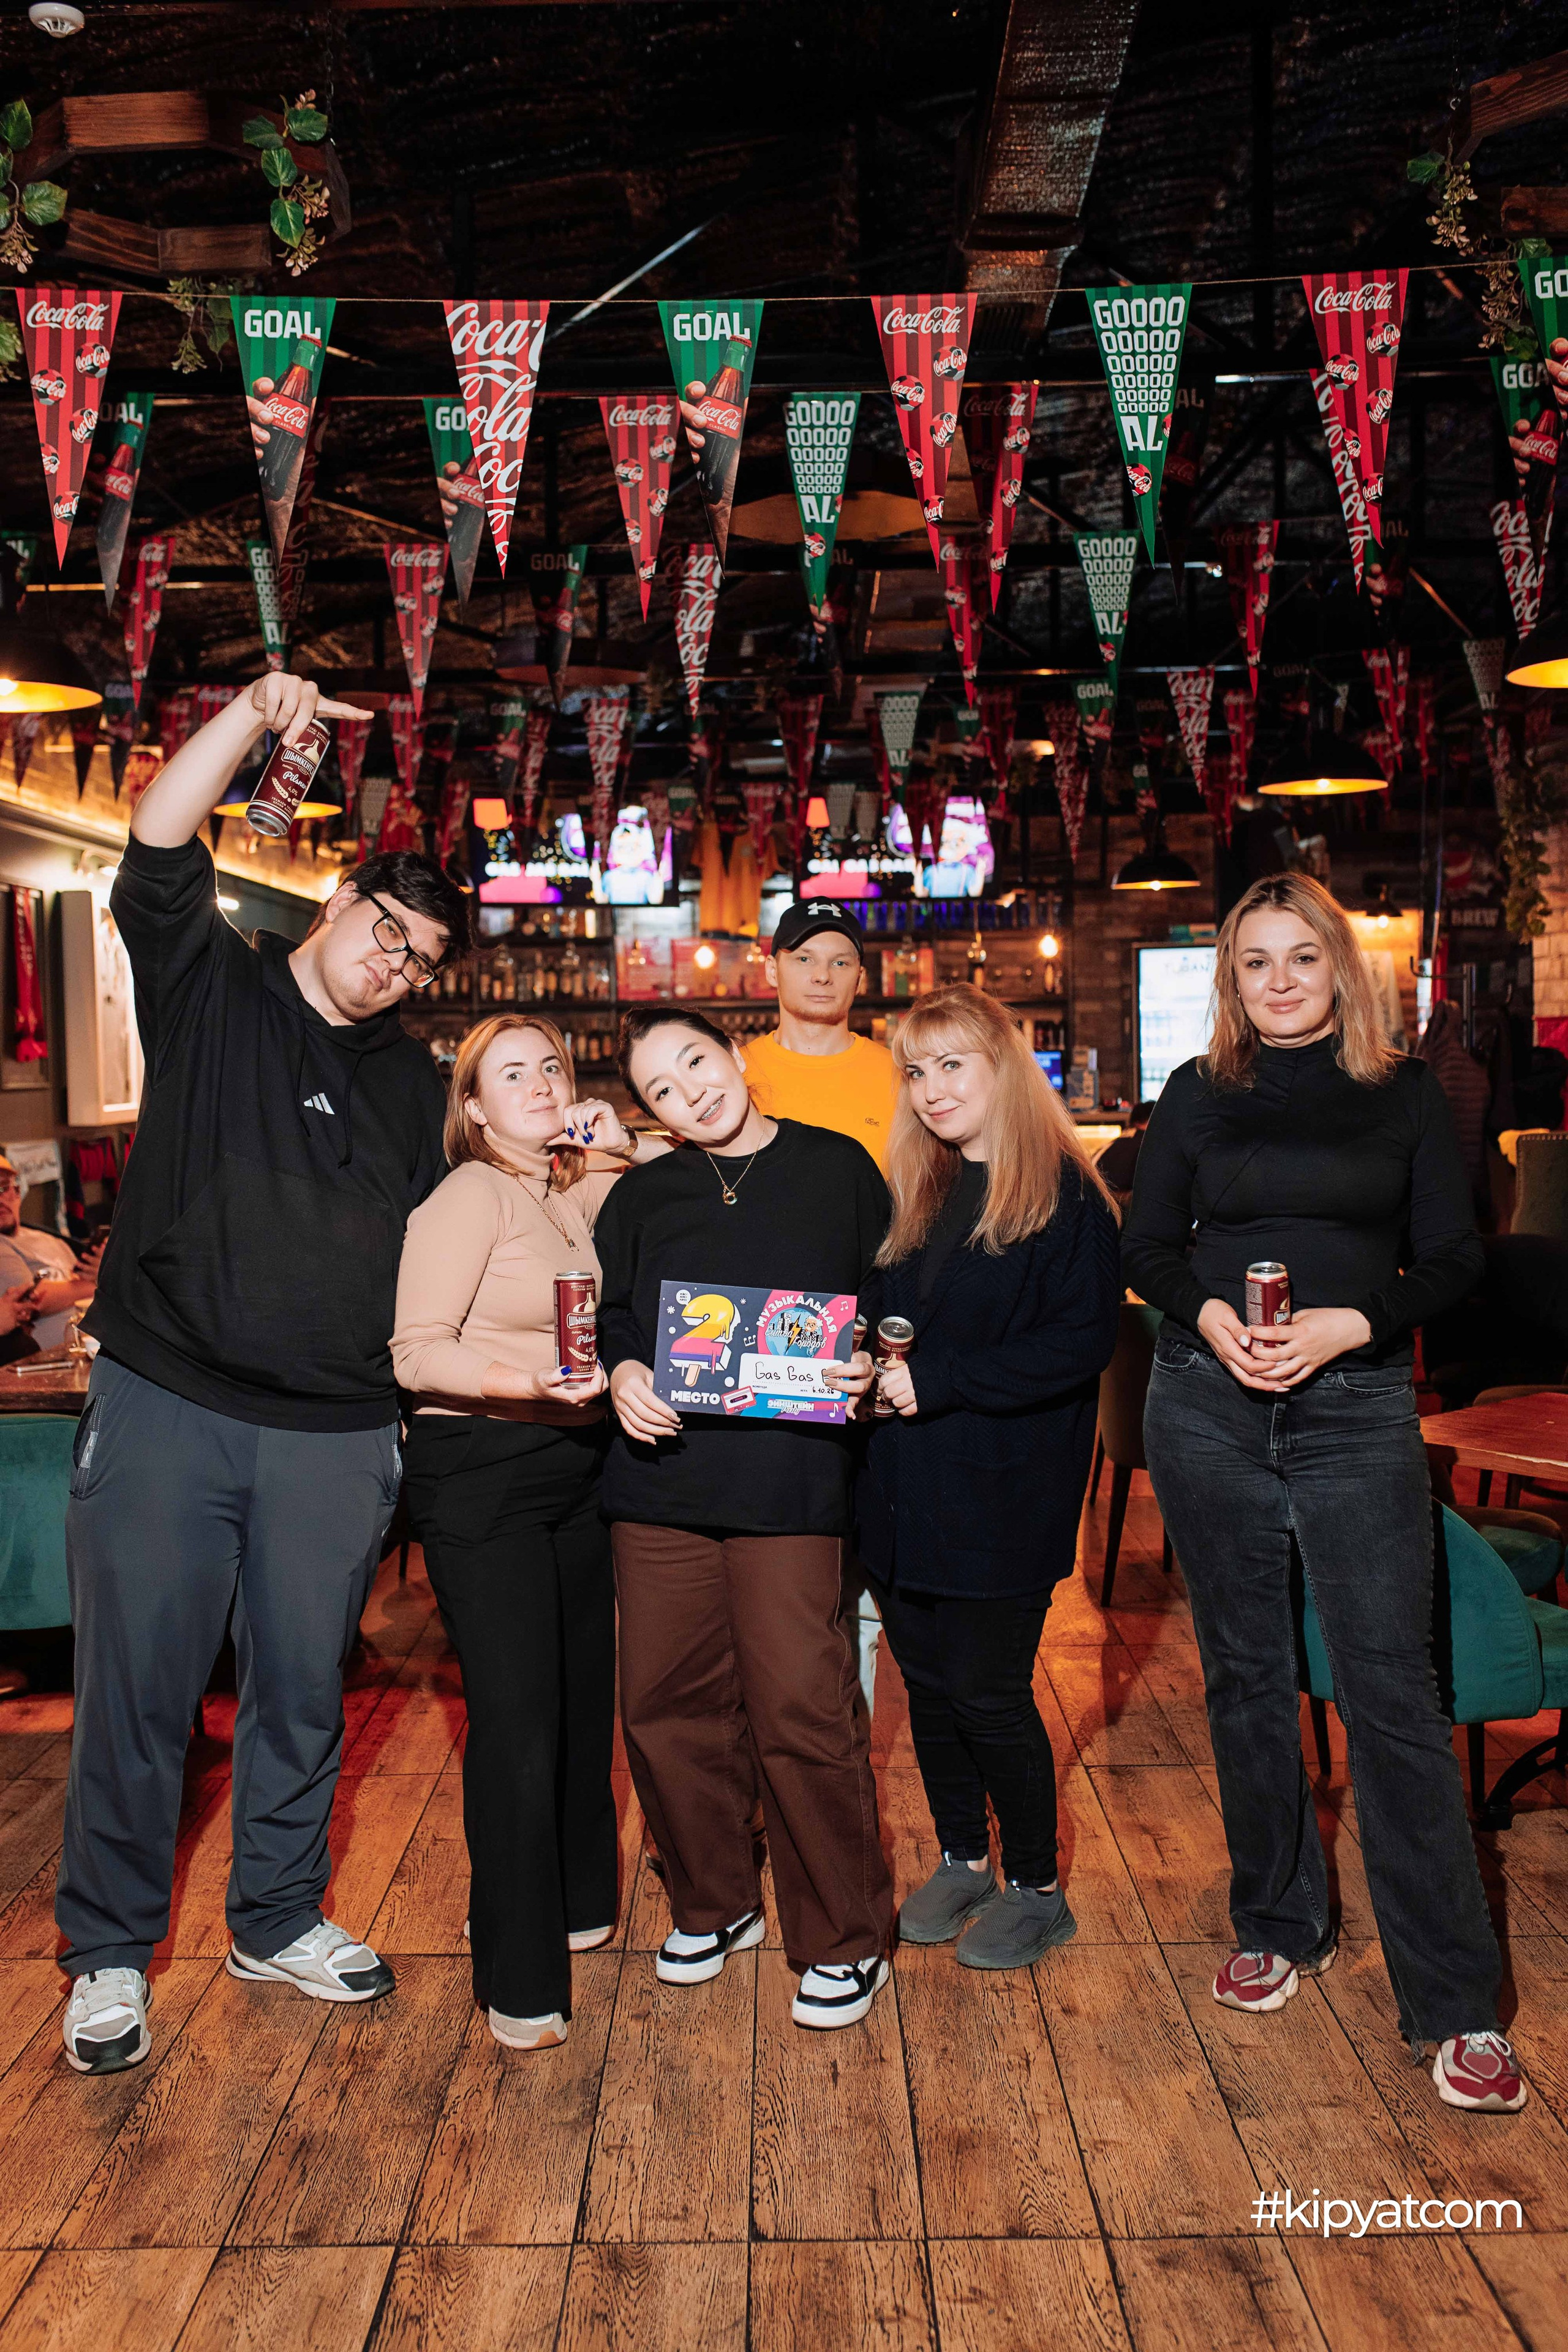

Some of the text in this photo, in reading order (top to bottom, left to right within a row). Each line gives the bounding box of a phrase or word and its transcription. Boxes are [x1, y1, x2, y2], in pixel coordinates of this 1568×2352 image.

[1315, 281, 1396, 314] Coca-Cola
[26, 301, 109, 331] Coca-Cola
[244, 309, 322, 339] GOAL
[674, 312, 750, 341] GOAL
[883, 306, 965, 334] Coca-Cola
[1094, 296, 1185, 329] GOOOO
[265, 398, 308, 429] Coca-Cola
[609, 404, 674, 427] Coca-Cola
[699, 401, 741, 430] Coca-Cola
[783, 400, 856, 426] GOOOO
[786, 428, 851, 446] OOOOO
[1120, 415, 1163, 451] AL
[800, 495, 835, 523] AL
[530, 552, 579, 571] GOAL
[1077, 537, 1136, 559] GOOOO
[1095, 612, 1123, 635] AL
[287, 786, 298, 796] 4,0%
[756, 1295, 837, 1333] МУЗЫКАЛЬНАЯ
[669, 1294, 741, 1374] 2
[755, 1361, 781, 1380] Gas
[787, 1365, 814, 1382] Gas
[670, 1390, 720, 1405] МЕСТО
